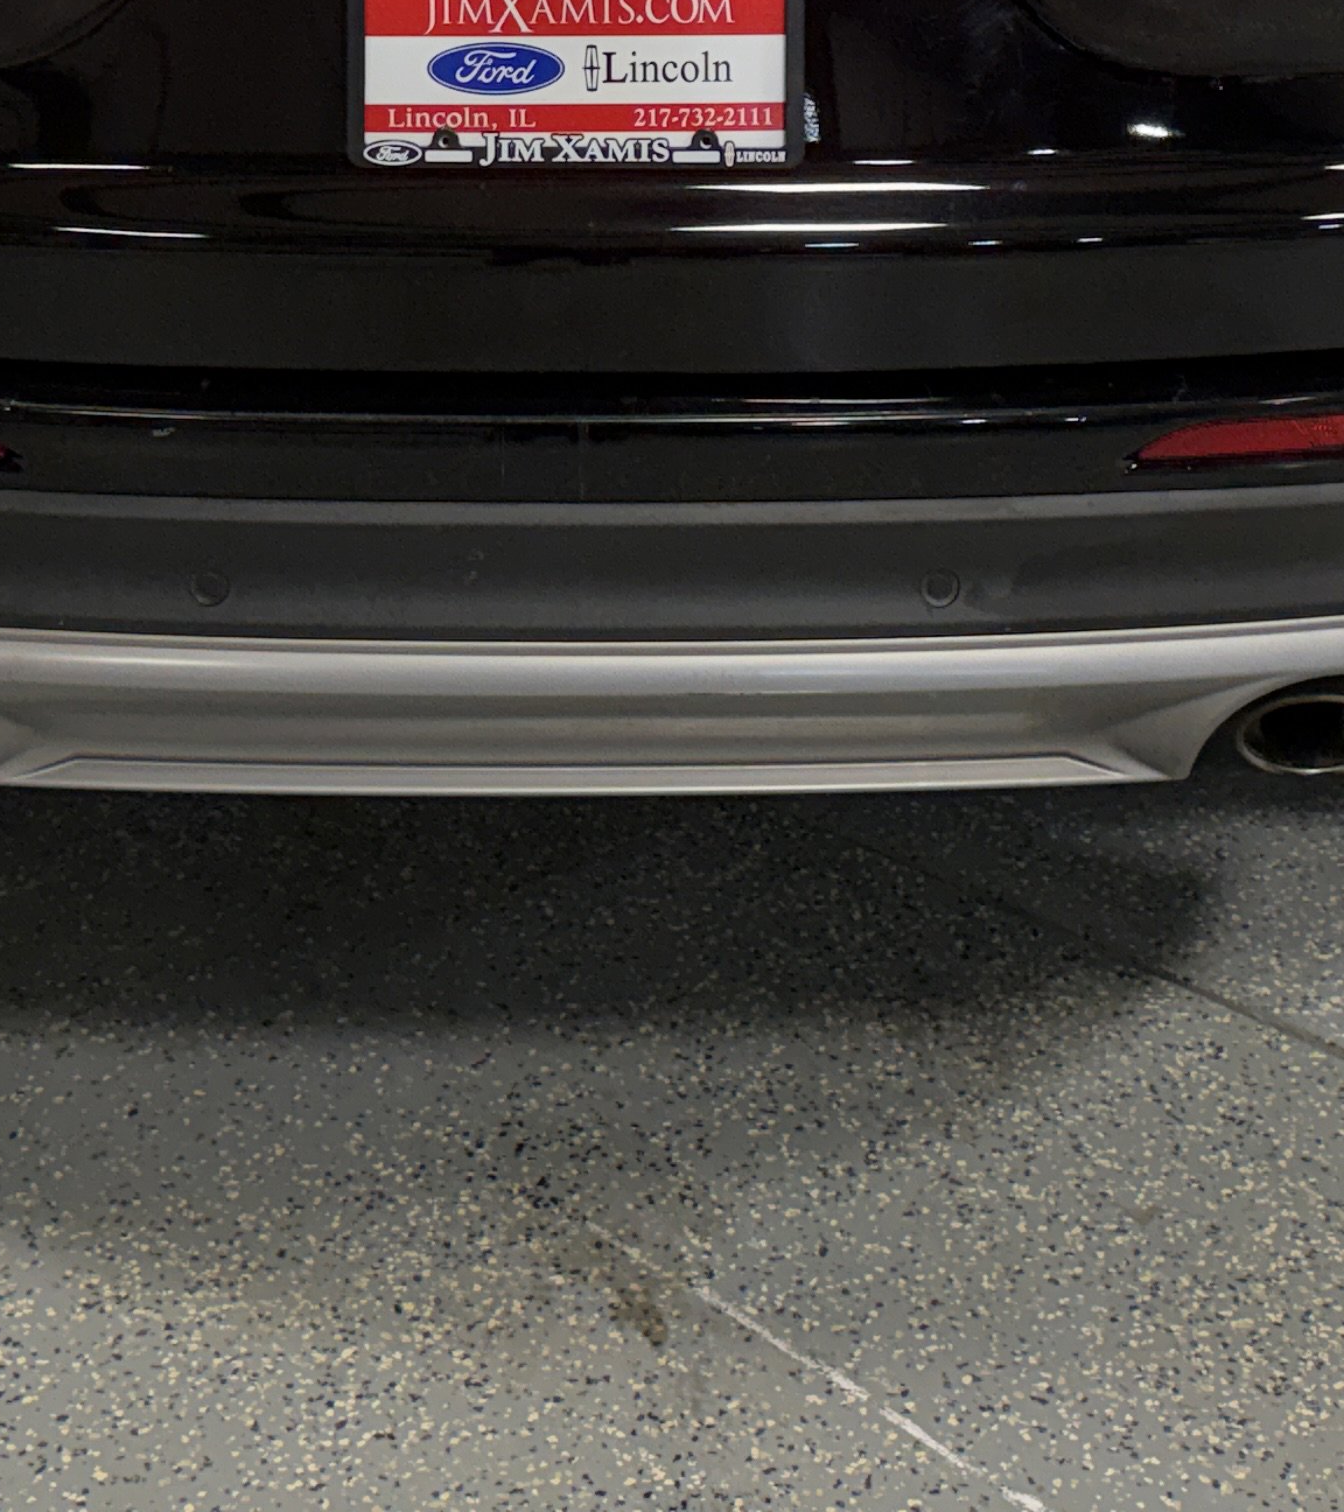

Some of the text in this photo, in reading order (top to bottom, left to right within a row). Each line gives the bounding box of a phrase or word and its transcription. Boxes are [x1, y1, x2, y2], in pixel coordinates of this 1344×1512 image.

[455, 48, 536, 85] Ford
[602, 50, 733, 84] Lincoln
[387, 107, 537, 130] Lincoln, IL
[633, 107, 774, 128] 217-732-2111
[375, 144, 409, 162] Ford
[478, 132, 670, 167] JIM XAMIS
[736, 150, 787, 163] LINCOLN
